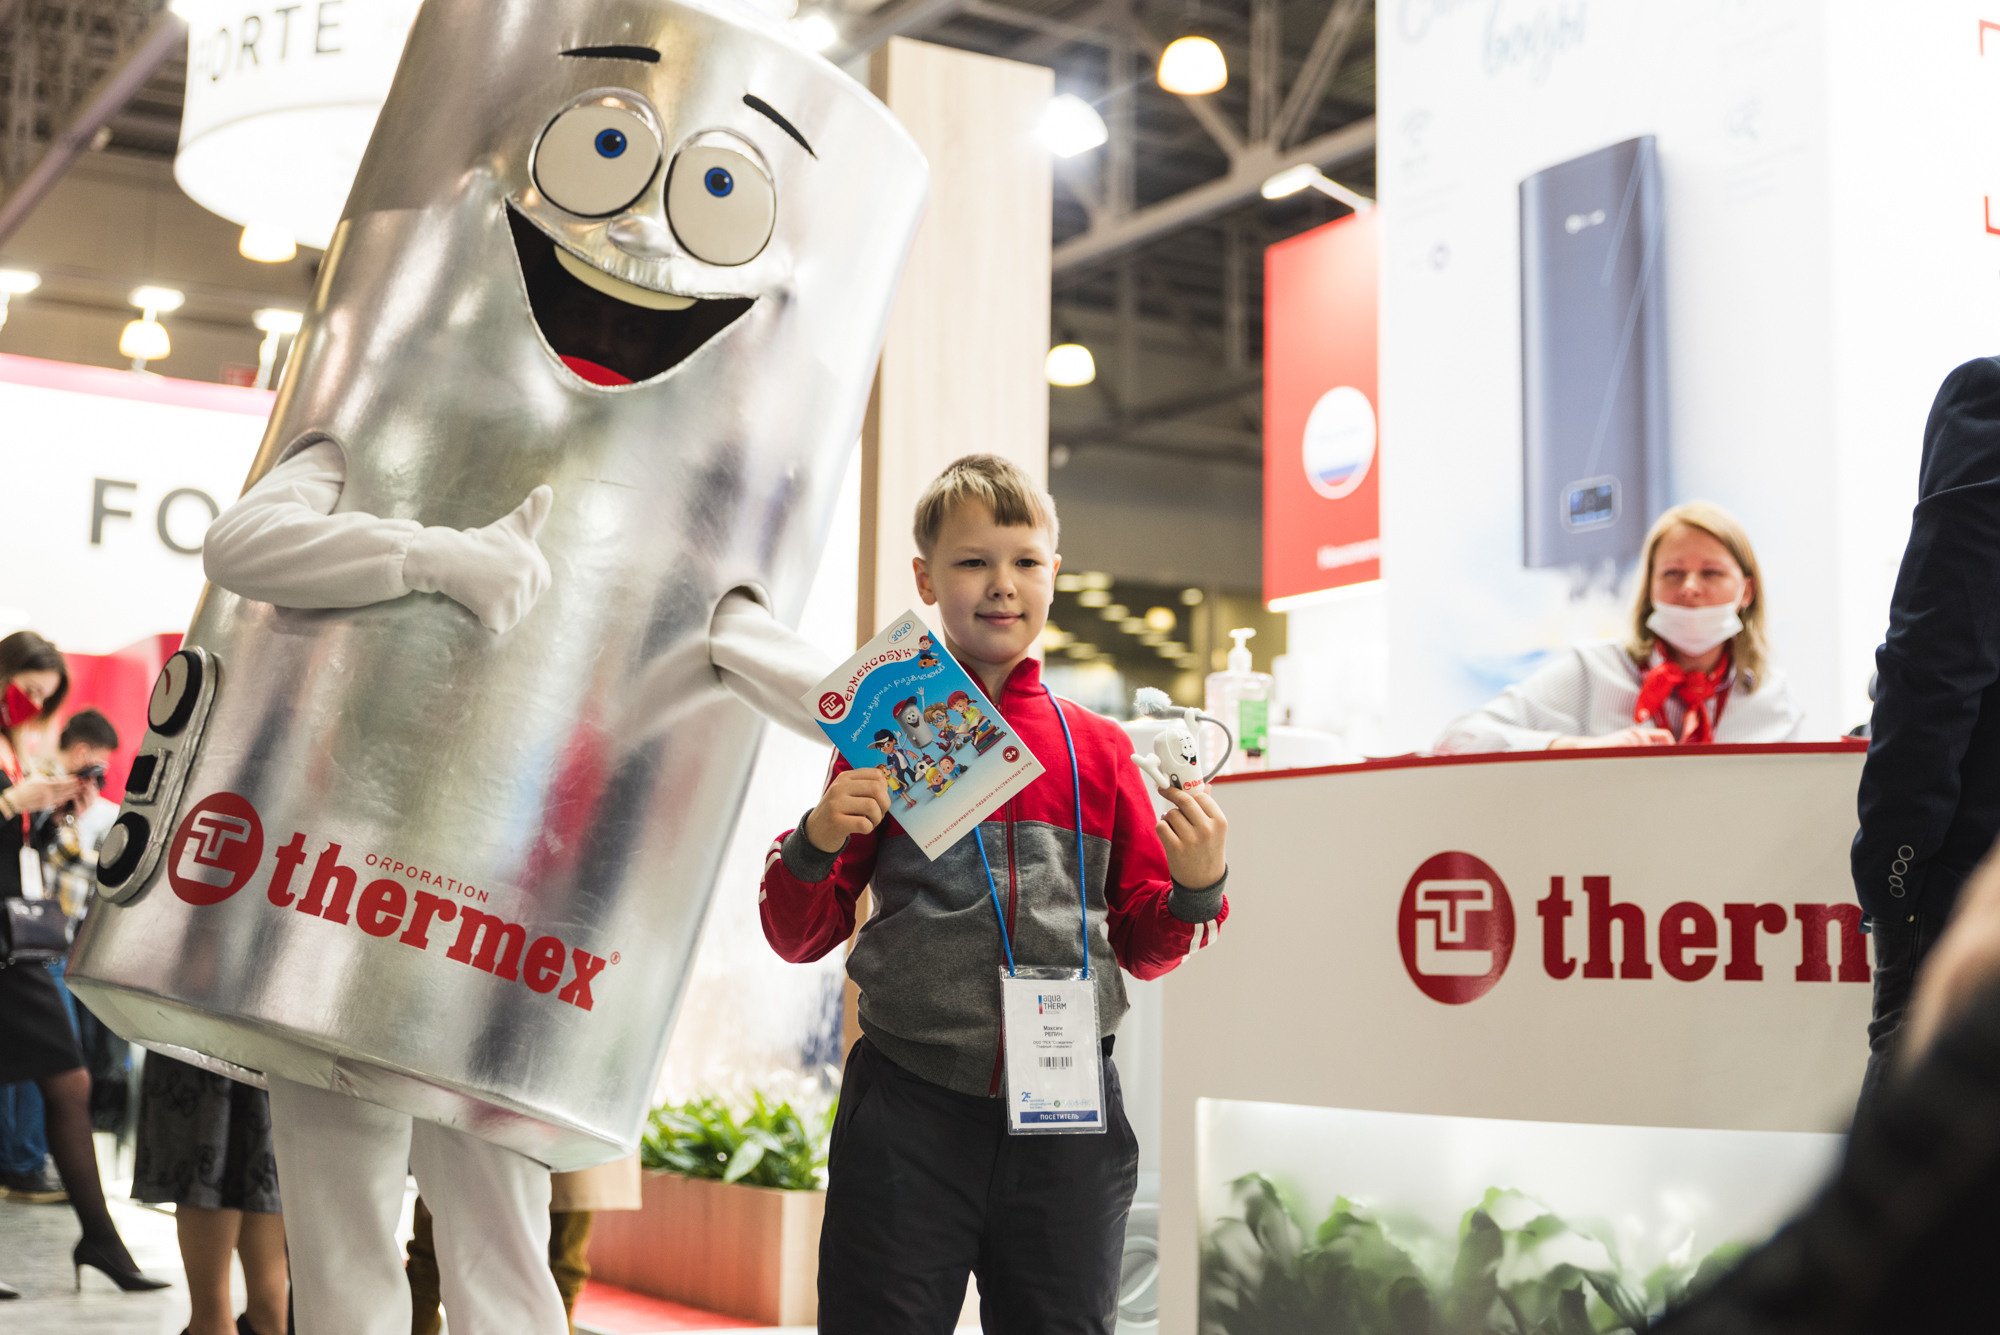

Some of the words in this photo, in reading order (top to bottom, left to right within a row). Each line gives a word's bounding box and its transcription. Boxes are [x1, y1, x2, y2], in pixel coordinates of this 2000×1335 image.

[91, 477, 220, 555] FO
[891, 622, 912, 642] 2020
[867, 683, 893, 711] журнал
[1005, 750, 1017, 760] 3+
[365, 853, 490, 903] ORPORATION
[267, 831, 607, 1011] thermex
[1043, 994, 1061, 1003] aqua
[1043, 1002, 1067, 1010] THERM
[1040, 1113, 1080, 1121] ПОСЕТИТЕЛЬ
